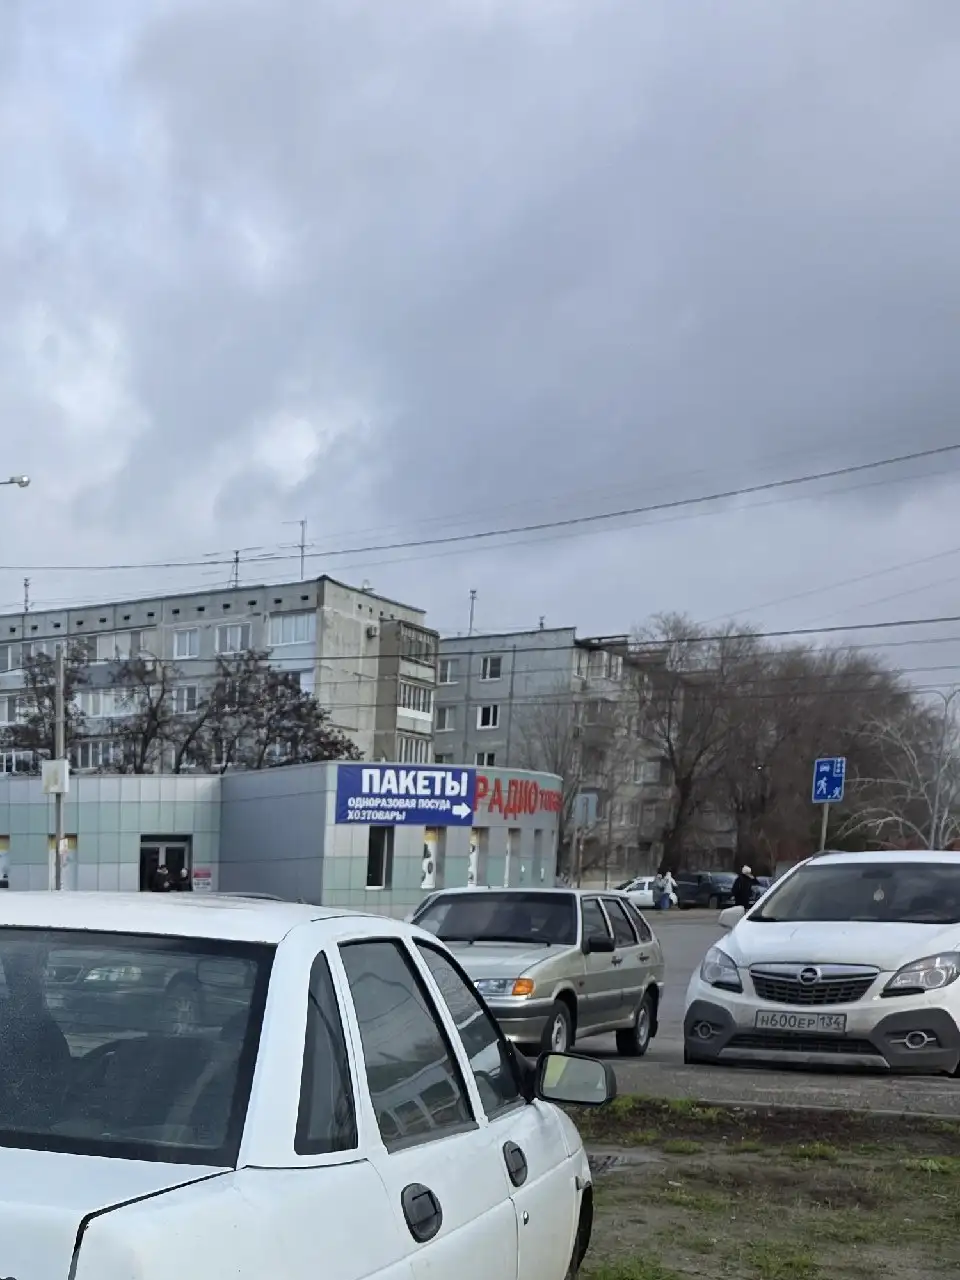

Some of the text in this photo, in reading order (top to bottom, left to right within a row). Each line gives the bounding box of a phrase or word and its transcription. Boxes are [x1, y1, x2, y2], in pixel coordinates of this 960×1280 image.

[361, 768, 468, 797] ПАКЕТЫ
[347, 797, 451, 811] ОДНОРАЗОВАЯ ПОСУДА
[472, 775, 539, 820] РАДИО
[347, 809, 407, 821] ХОЗТОВАРЫ
